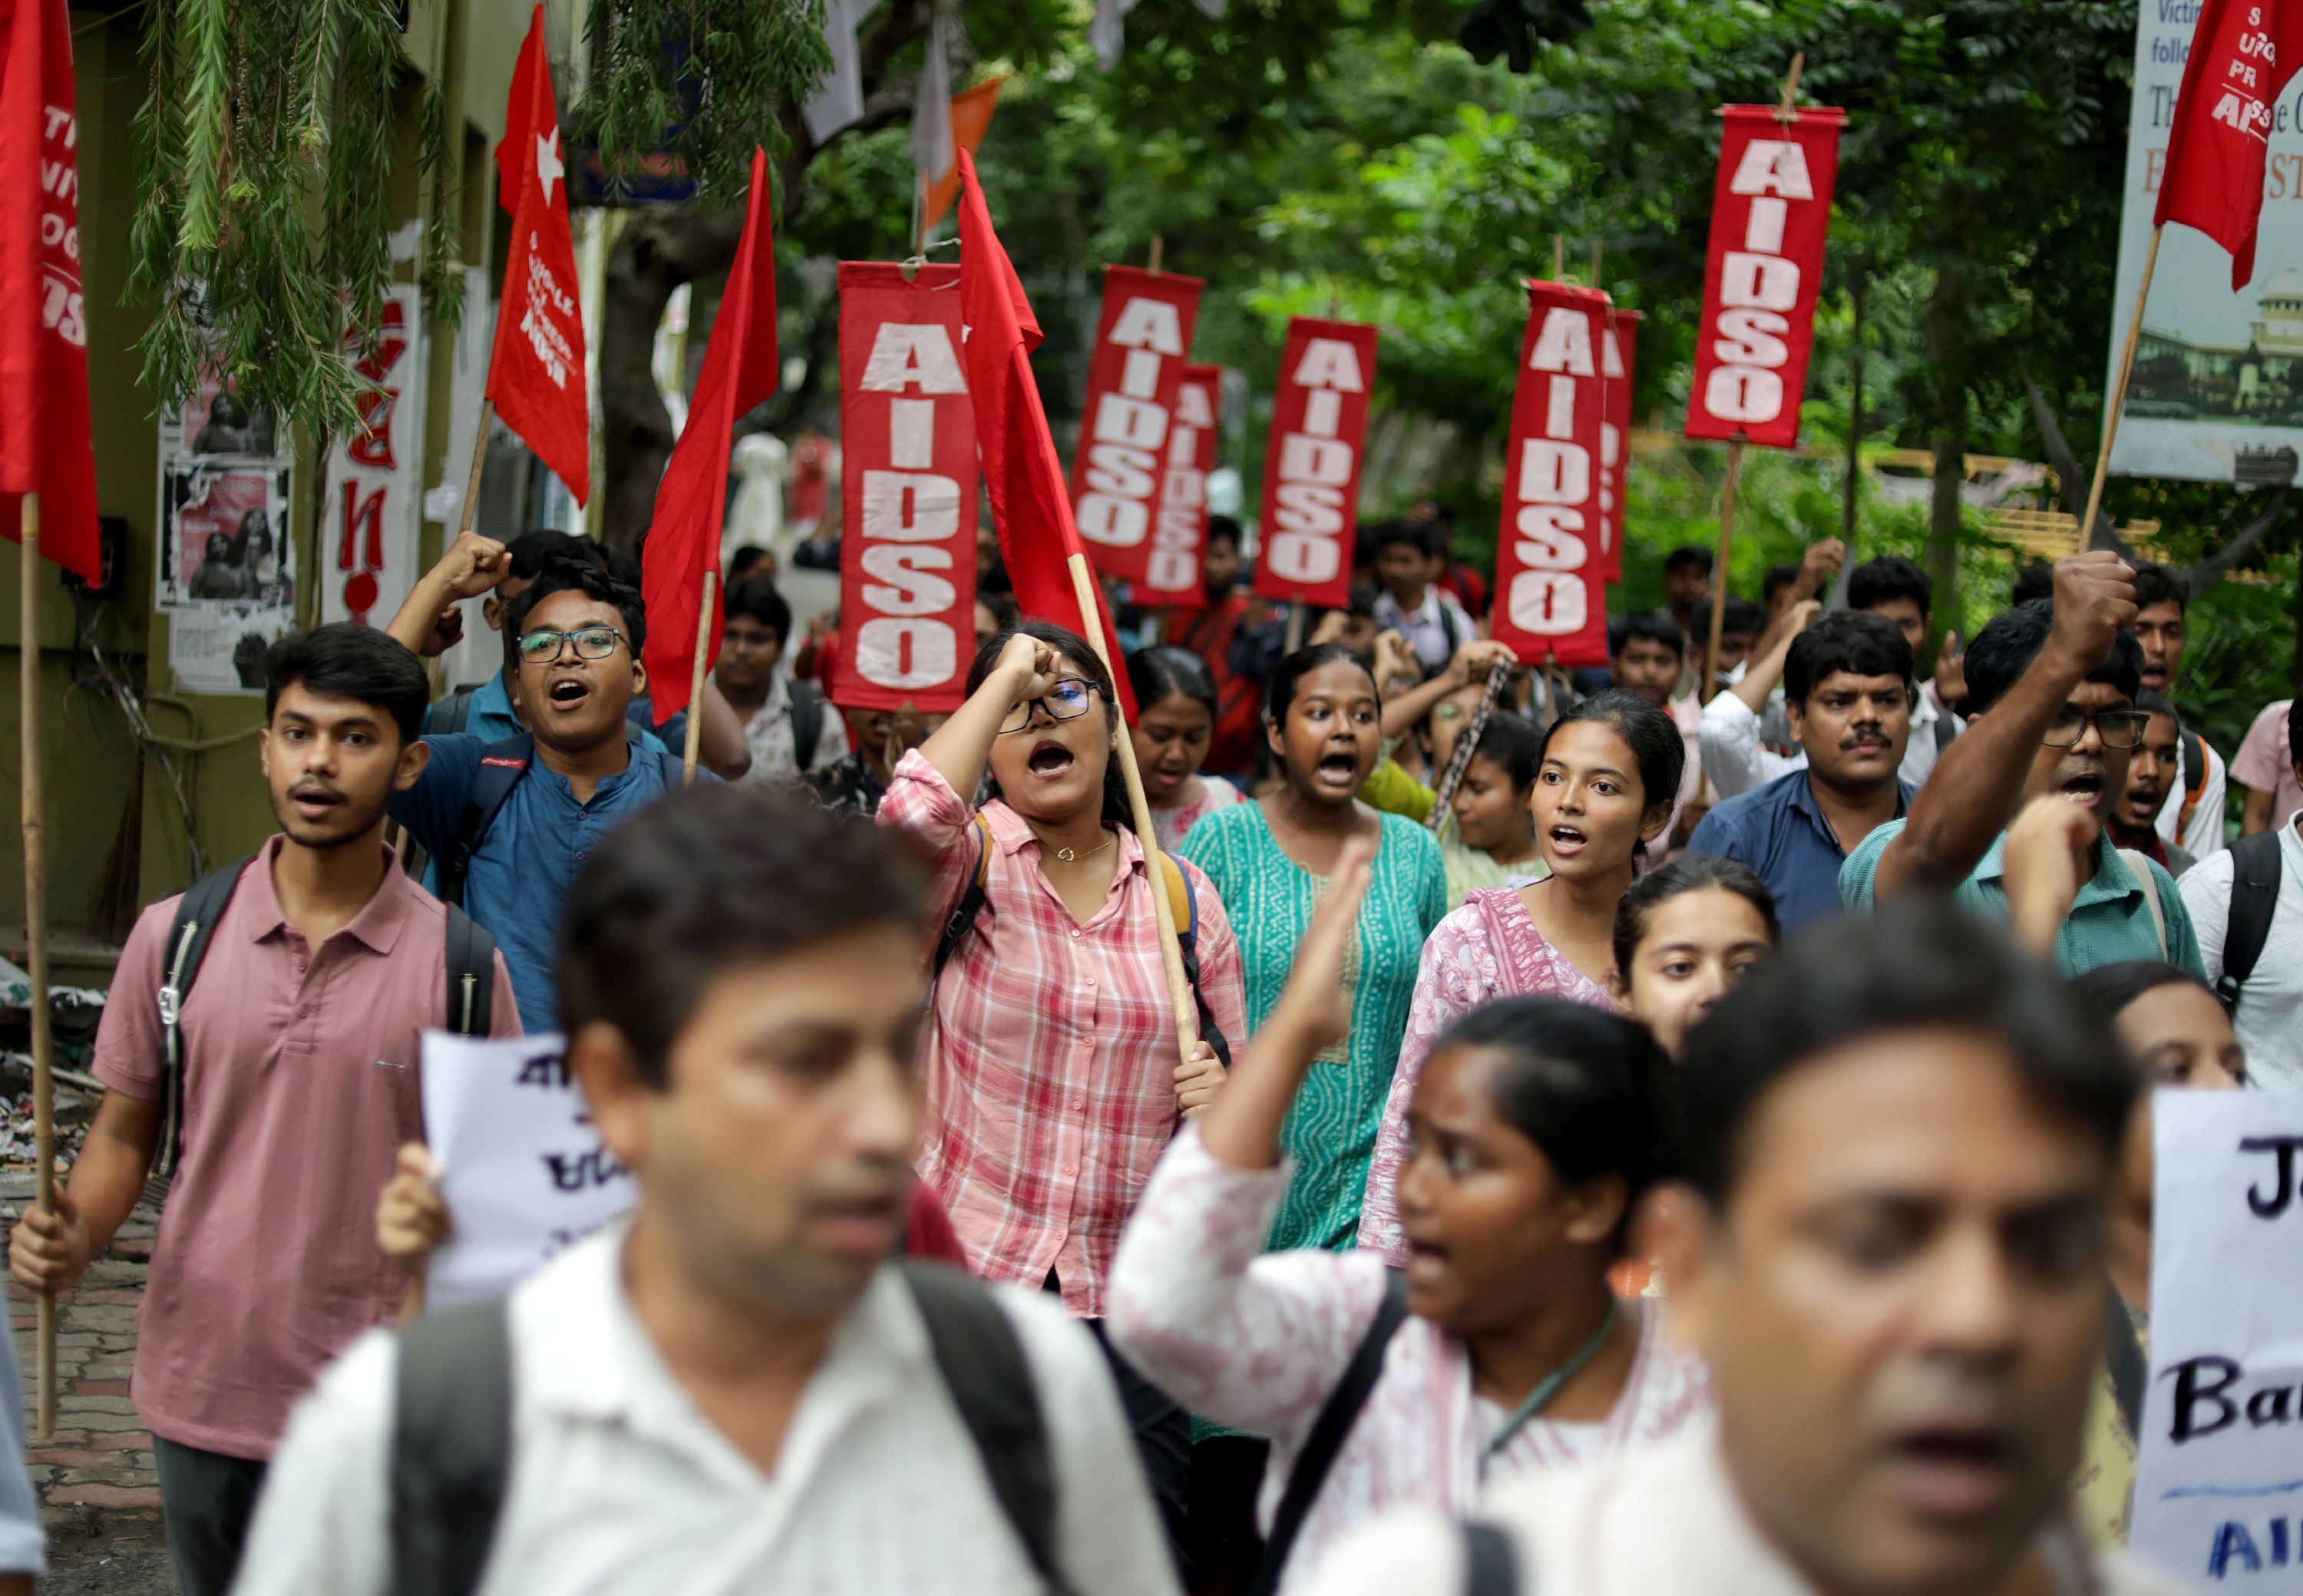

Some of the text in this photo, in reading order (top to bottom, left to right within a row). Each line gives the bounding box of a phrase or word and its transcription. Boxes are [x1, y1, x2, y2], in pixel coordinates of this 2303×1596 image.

[1703, 138, 1815, 424] AIDSO
[856, 322, 970, 689] AIDSO
[1076, 296, 1185, 547] AIDSO
[1267, 337, 1365, 583] AIDSO
[1508, 307, 1595, 636] AIDSO
[2158, 1355, 2303, 1446] Ba
[2207, 1516, 2303, 1580] AI
